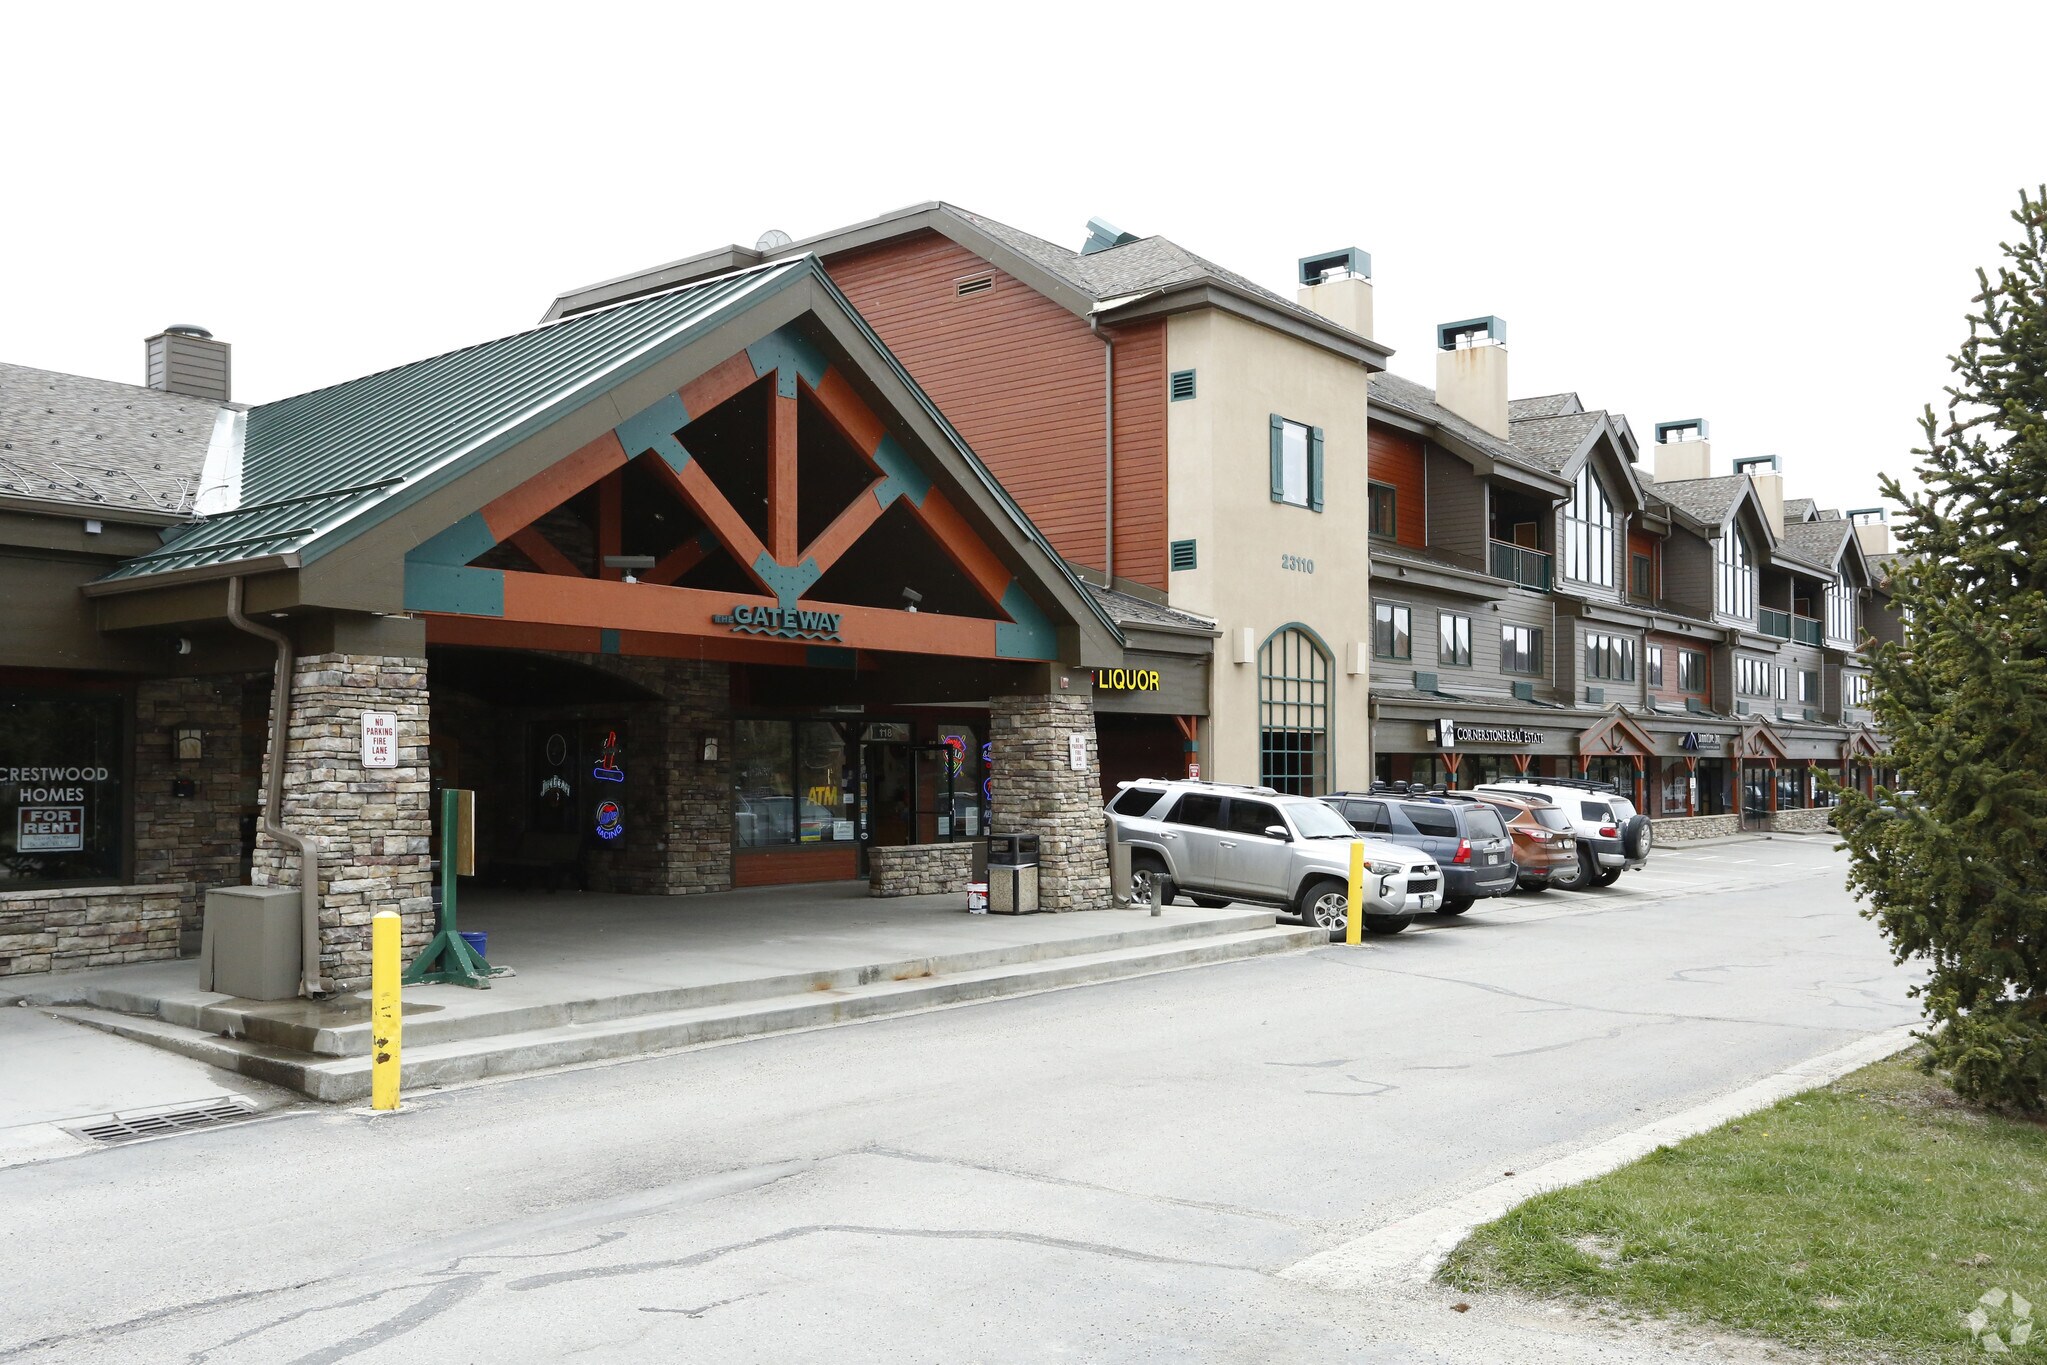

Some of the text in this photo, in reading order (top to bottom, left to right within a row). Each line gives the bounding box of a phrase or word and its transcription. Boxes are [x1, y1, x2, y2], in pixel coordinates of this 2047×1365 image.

[1281, 553, 1314, 574] 23110
[714, 604, 843, 632] THE GATEWAY
[1099, 669, 1159, 691] LIQUOR
[375, 718, 383, 726] NO
[366, 728, 393, 736] PARKING
[373, 737, 386, 745] FIRE
[0, 767, 108, 781] CRESTWOOD
[20, 788, 84, 802] HOMES
[806, 786, 838, 806] ATM
[30, 810, 71, 822] FOR
[23, 822, 78, 834] RENT
[596, 824, 623, 840] RACING
